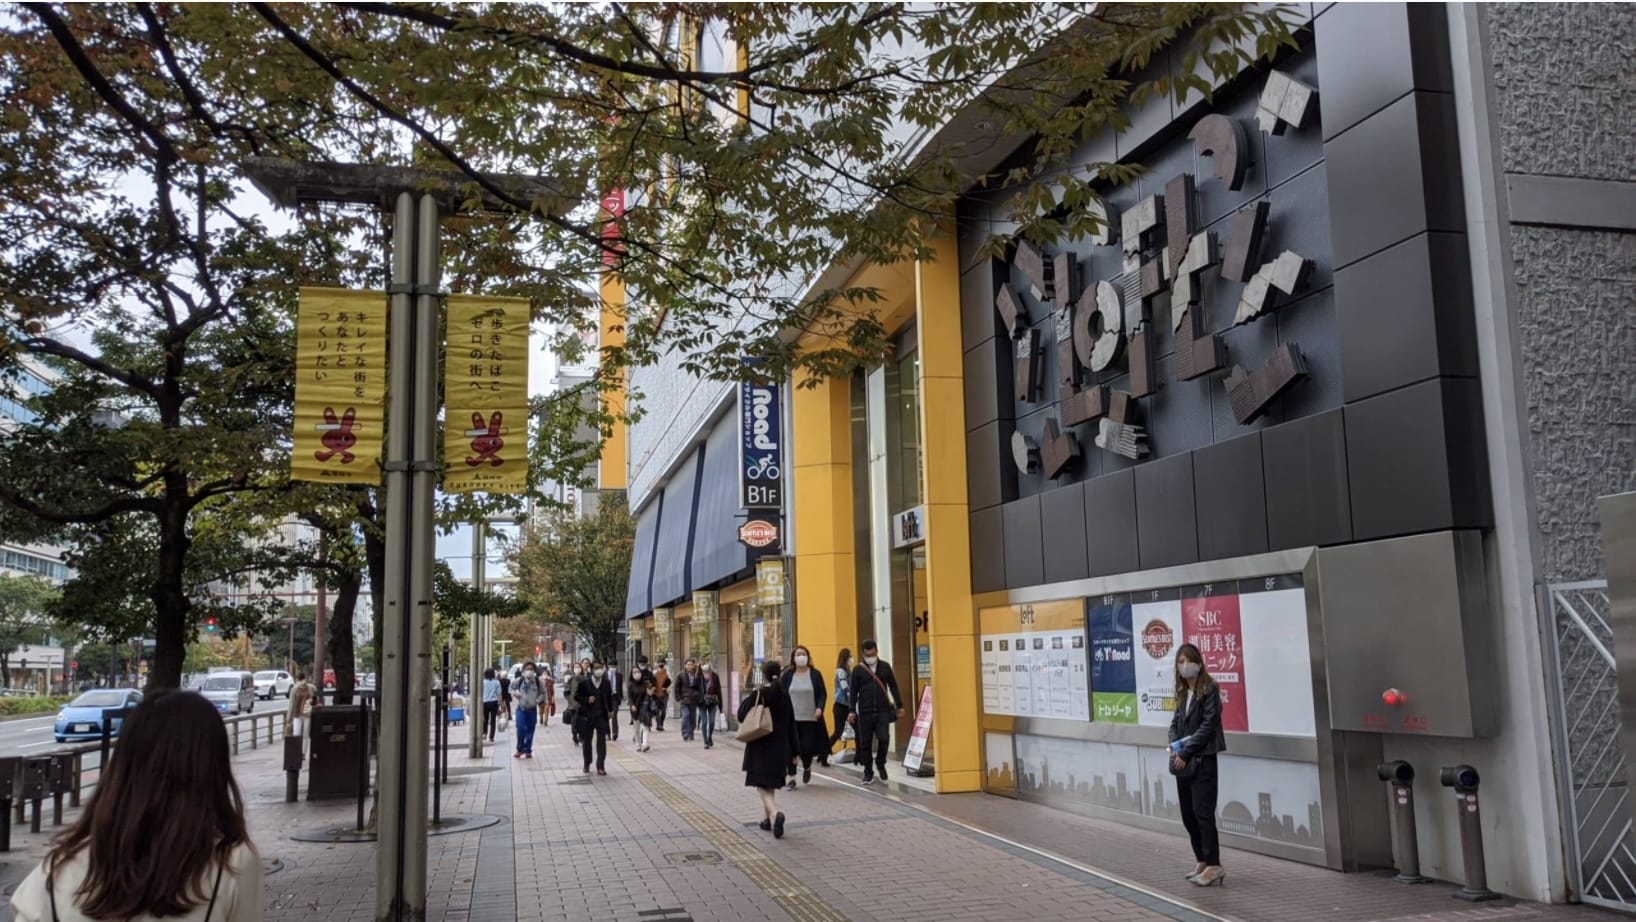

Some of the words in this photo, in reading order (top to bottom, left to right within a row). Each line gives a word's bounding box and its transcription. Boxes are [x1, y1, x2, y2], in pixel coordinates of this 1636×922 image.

[315, 312, 329, 380] つくりたい
[336, 312, 348, 367] あなたと
[747, 485, 777, 504] B1F
[1203, 585, 1213, 596] 7F
[1198, 610, 1222, 627] SBC
[1203, 653, 1236, 670] ニック
